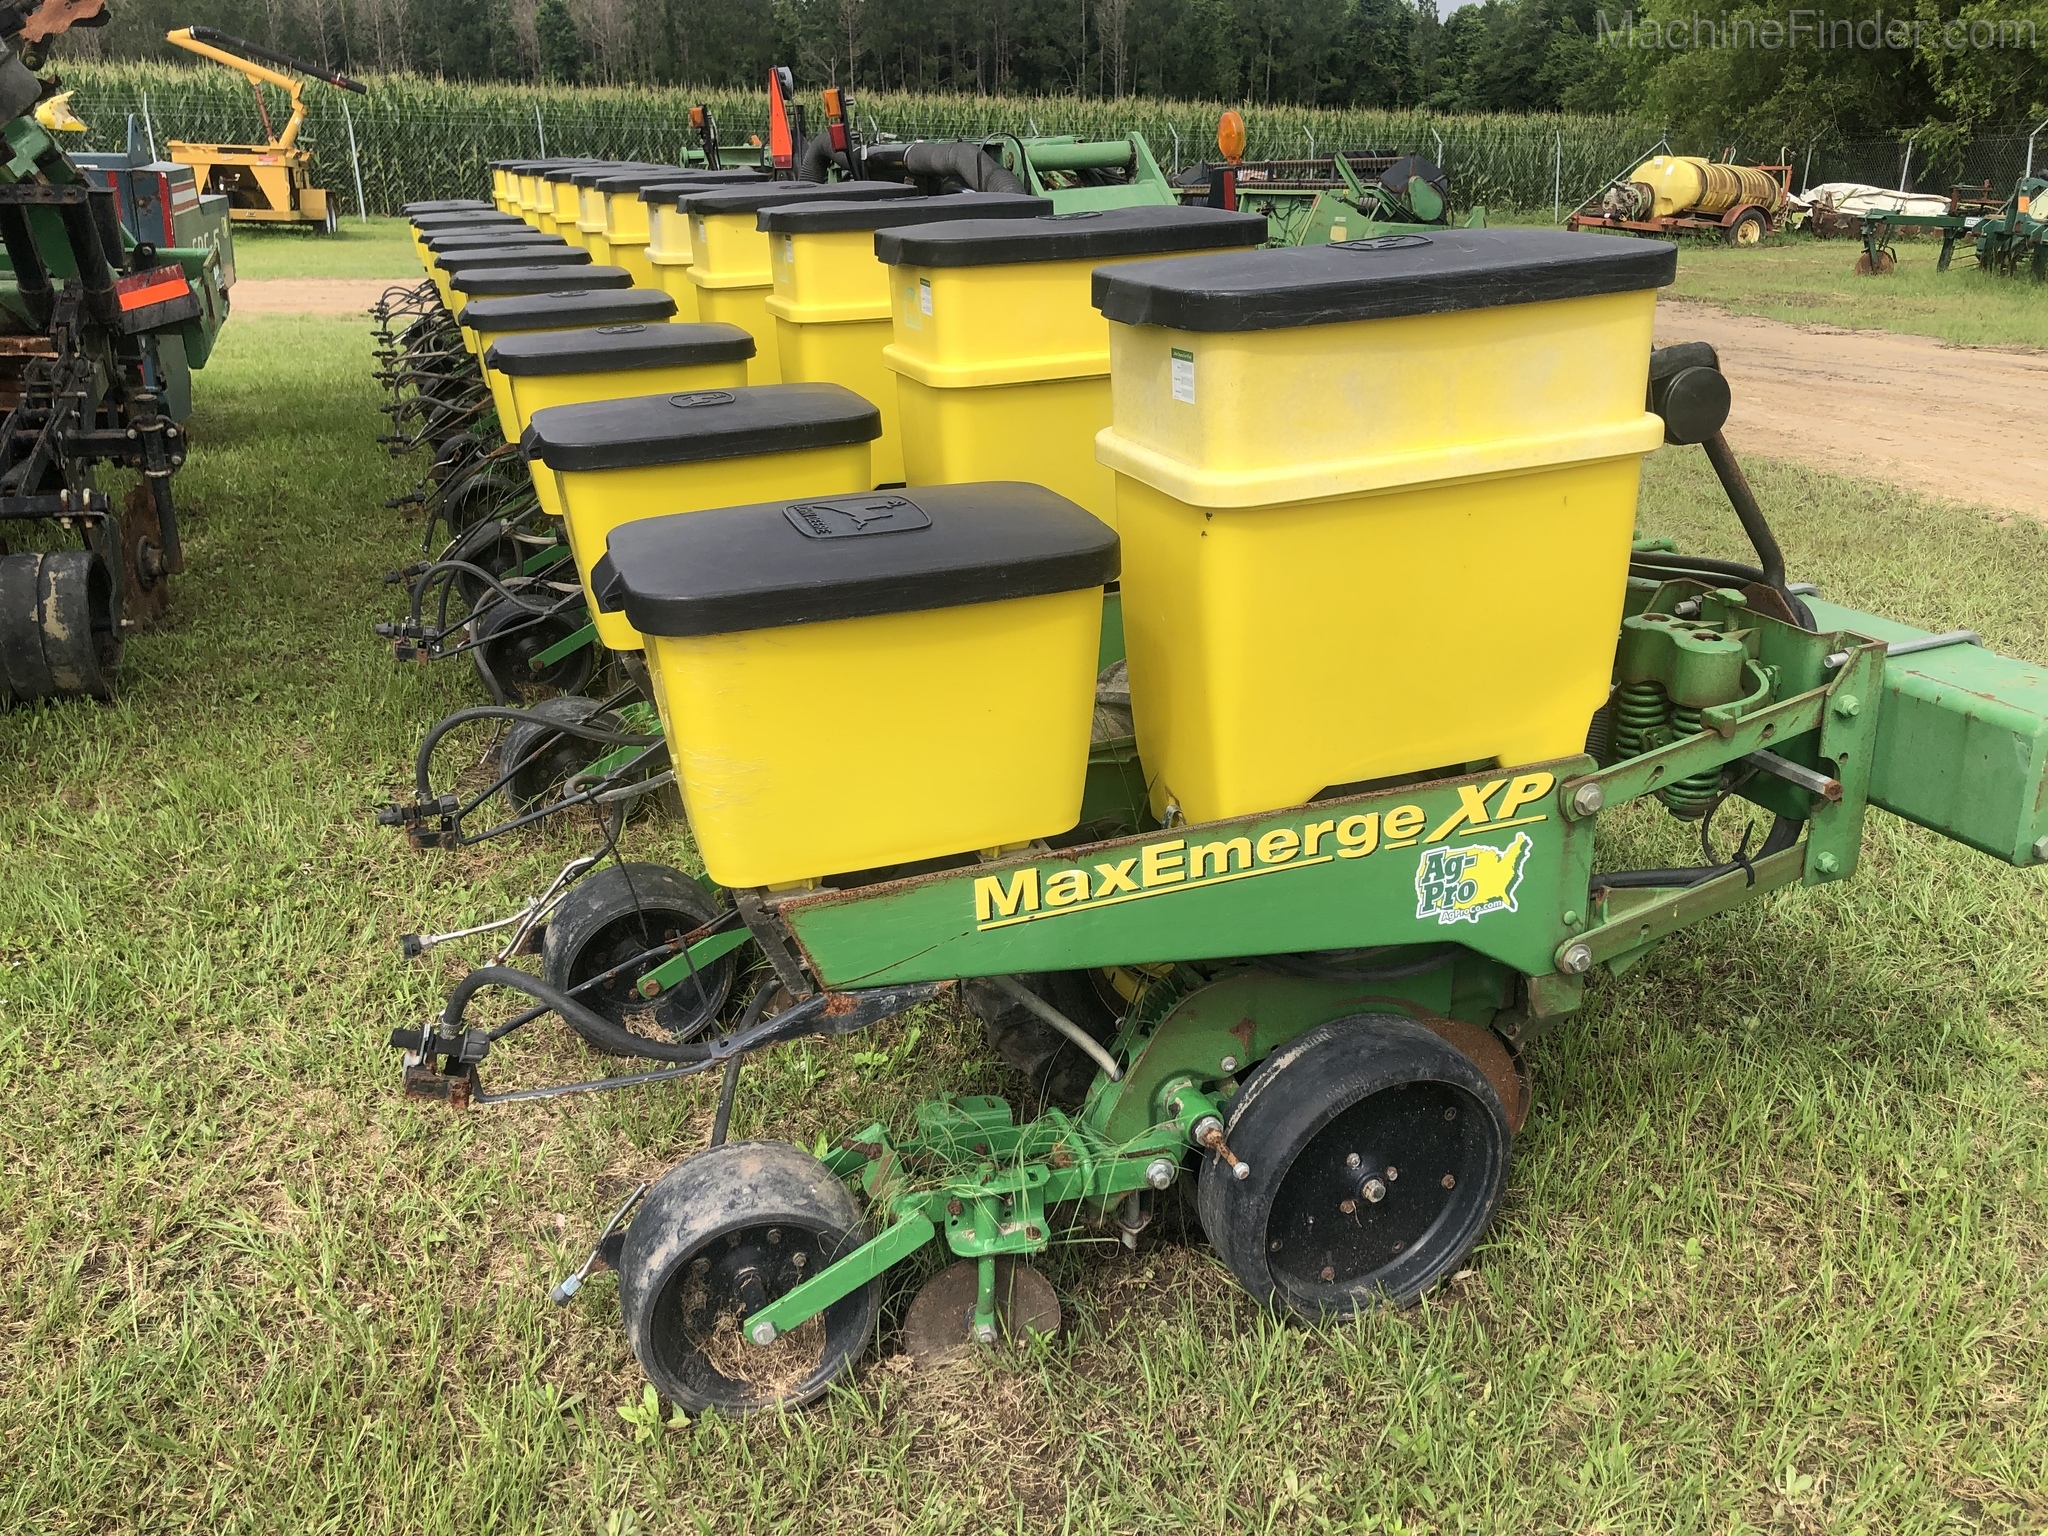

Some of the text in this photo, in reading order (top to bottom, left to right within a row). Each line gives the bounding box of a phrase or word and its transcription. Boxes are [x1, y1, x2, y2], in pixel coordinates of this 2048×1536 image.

[974, 772, 1557, 922] MaxEmerge XP
[1421, 849, 1478, 884] Ag-
[1420, 879, 1477, 914] Pro
[1440, 900, 1503, 922] AgProCo.com
